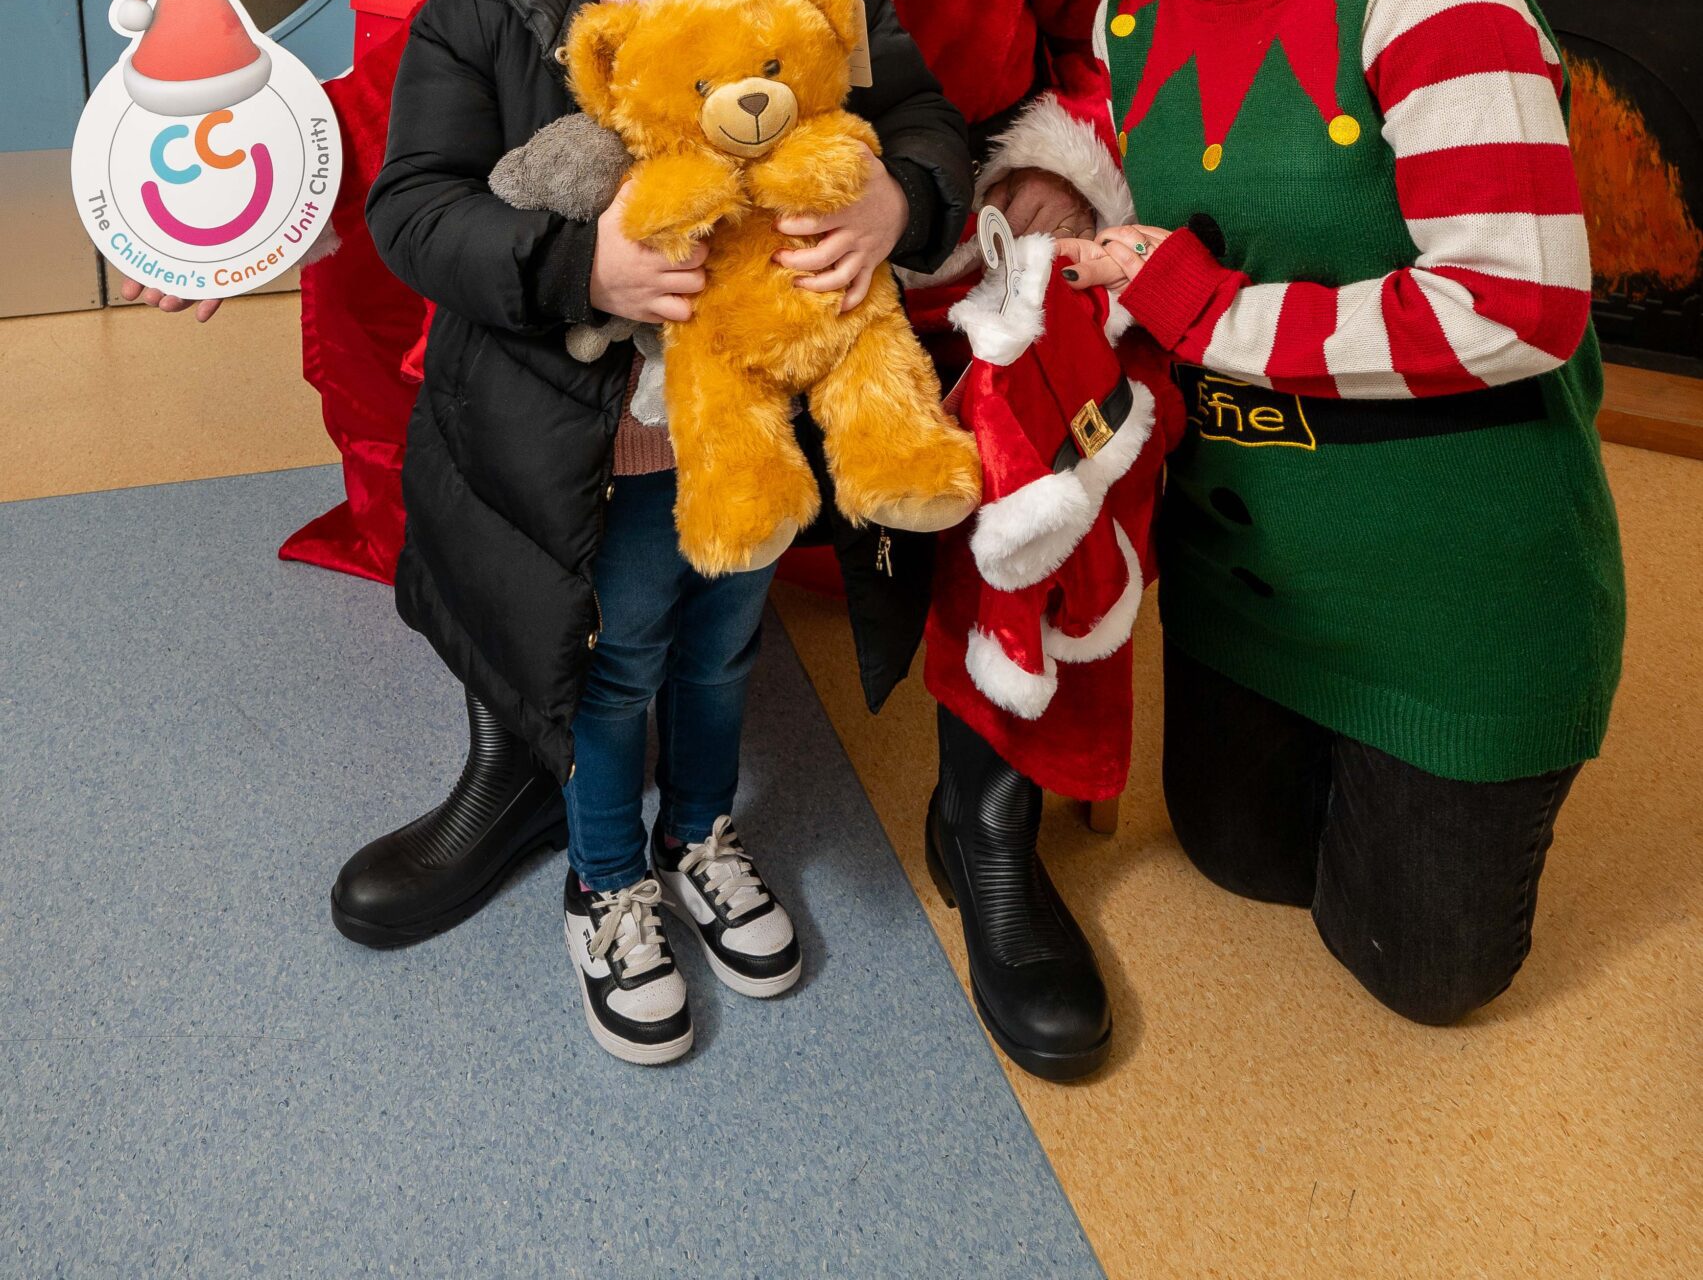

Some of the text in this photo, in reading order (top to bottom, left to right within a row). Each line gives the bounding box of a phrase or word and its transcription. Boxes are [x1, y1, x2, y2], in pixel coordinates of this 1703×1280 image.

[88, 117, 328, 288] The Children's Cancer Unit Charity
